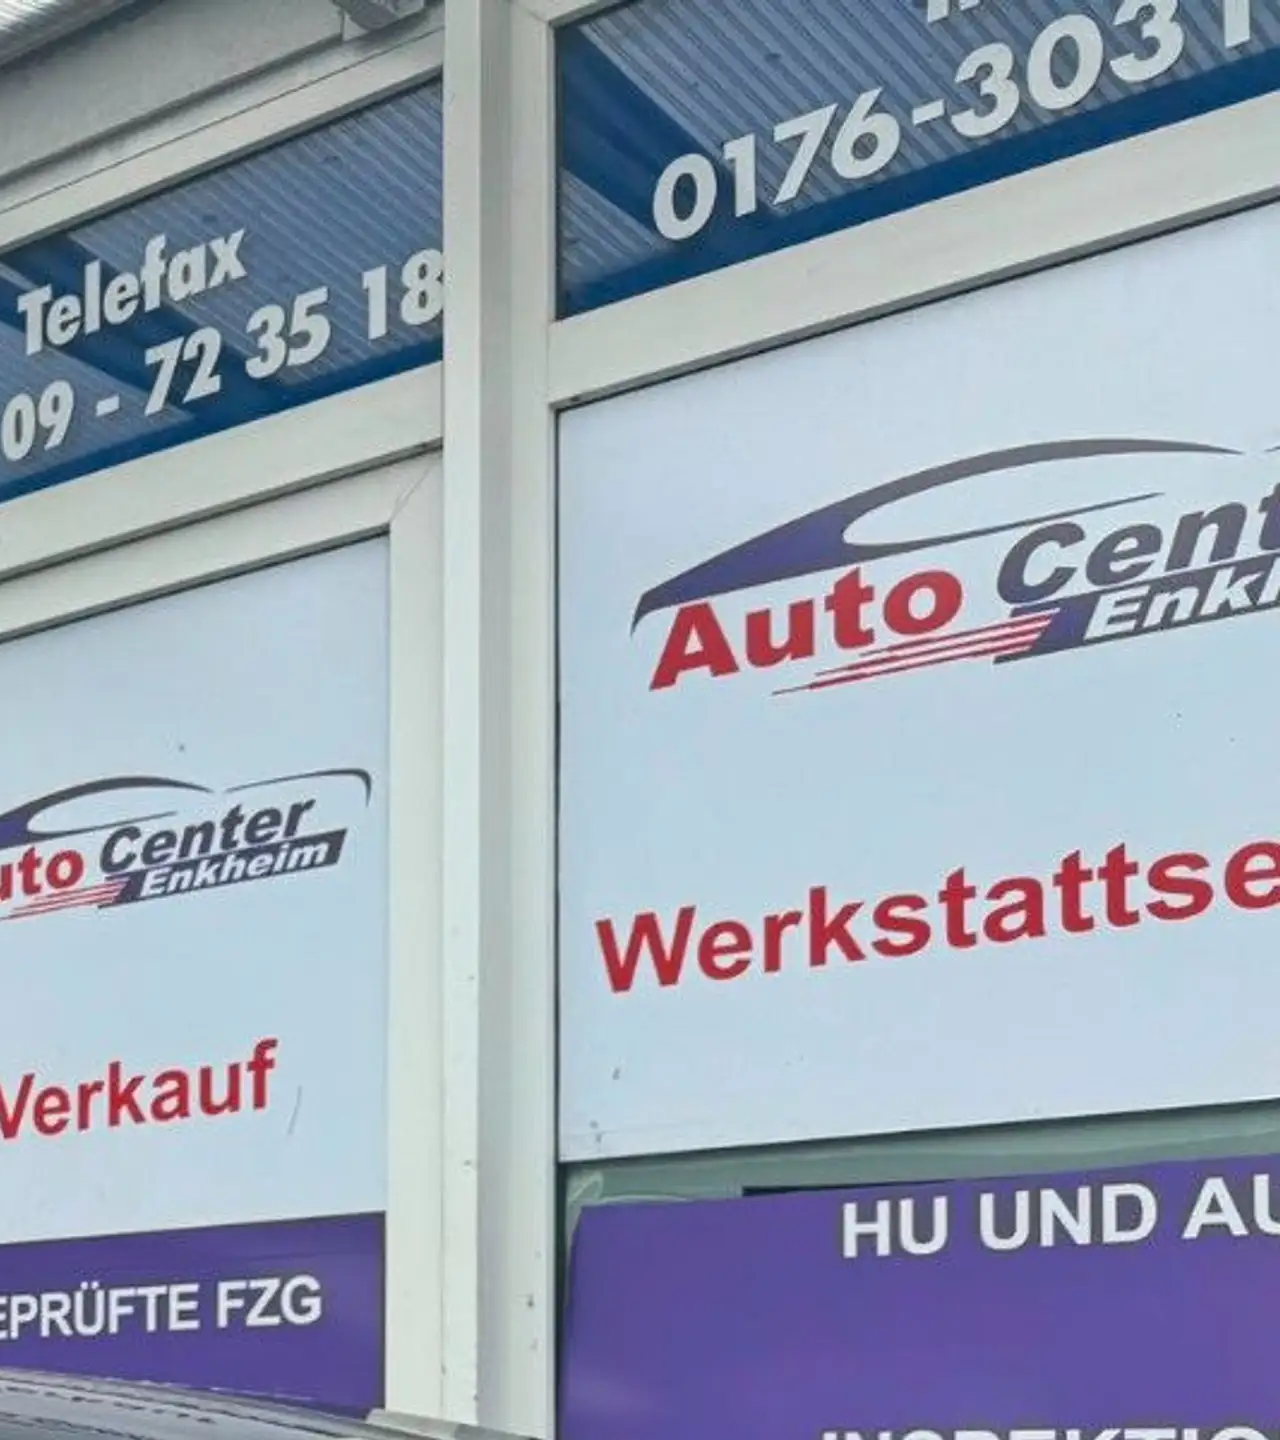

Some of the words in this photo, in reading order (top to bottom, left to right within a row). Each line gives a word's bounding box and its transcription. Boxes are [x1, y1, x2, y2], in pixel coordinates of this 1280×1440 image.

[17, 228, 247, 355] Telefax
[1, 379, 74, 461] 09
[143, 327, 223, 416] 72
[244, 289, 331, 379] 35
[361, 247, 442, 342] 18
[649, 566, 963, 691] Auto
[100, 799, 316, 873] Center
[139, 838, 330, 899] Enkheim
[595, 841, 1280, 993] Werkstattse
[842, 1196, 948, 1260] HU
[979, 1181, 1157, 1251] UND
[216, 1276, 322, 1329] FZG
